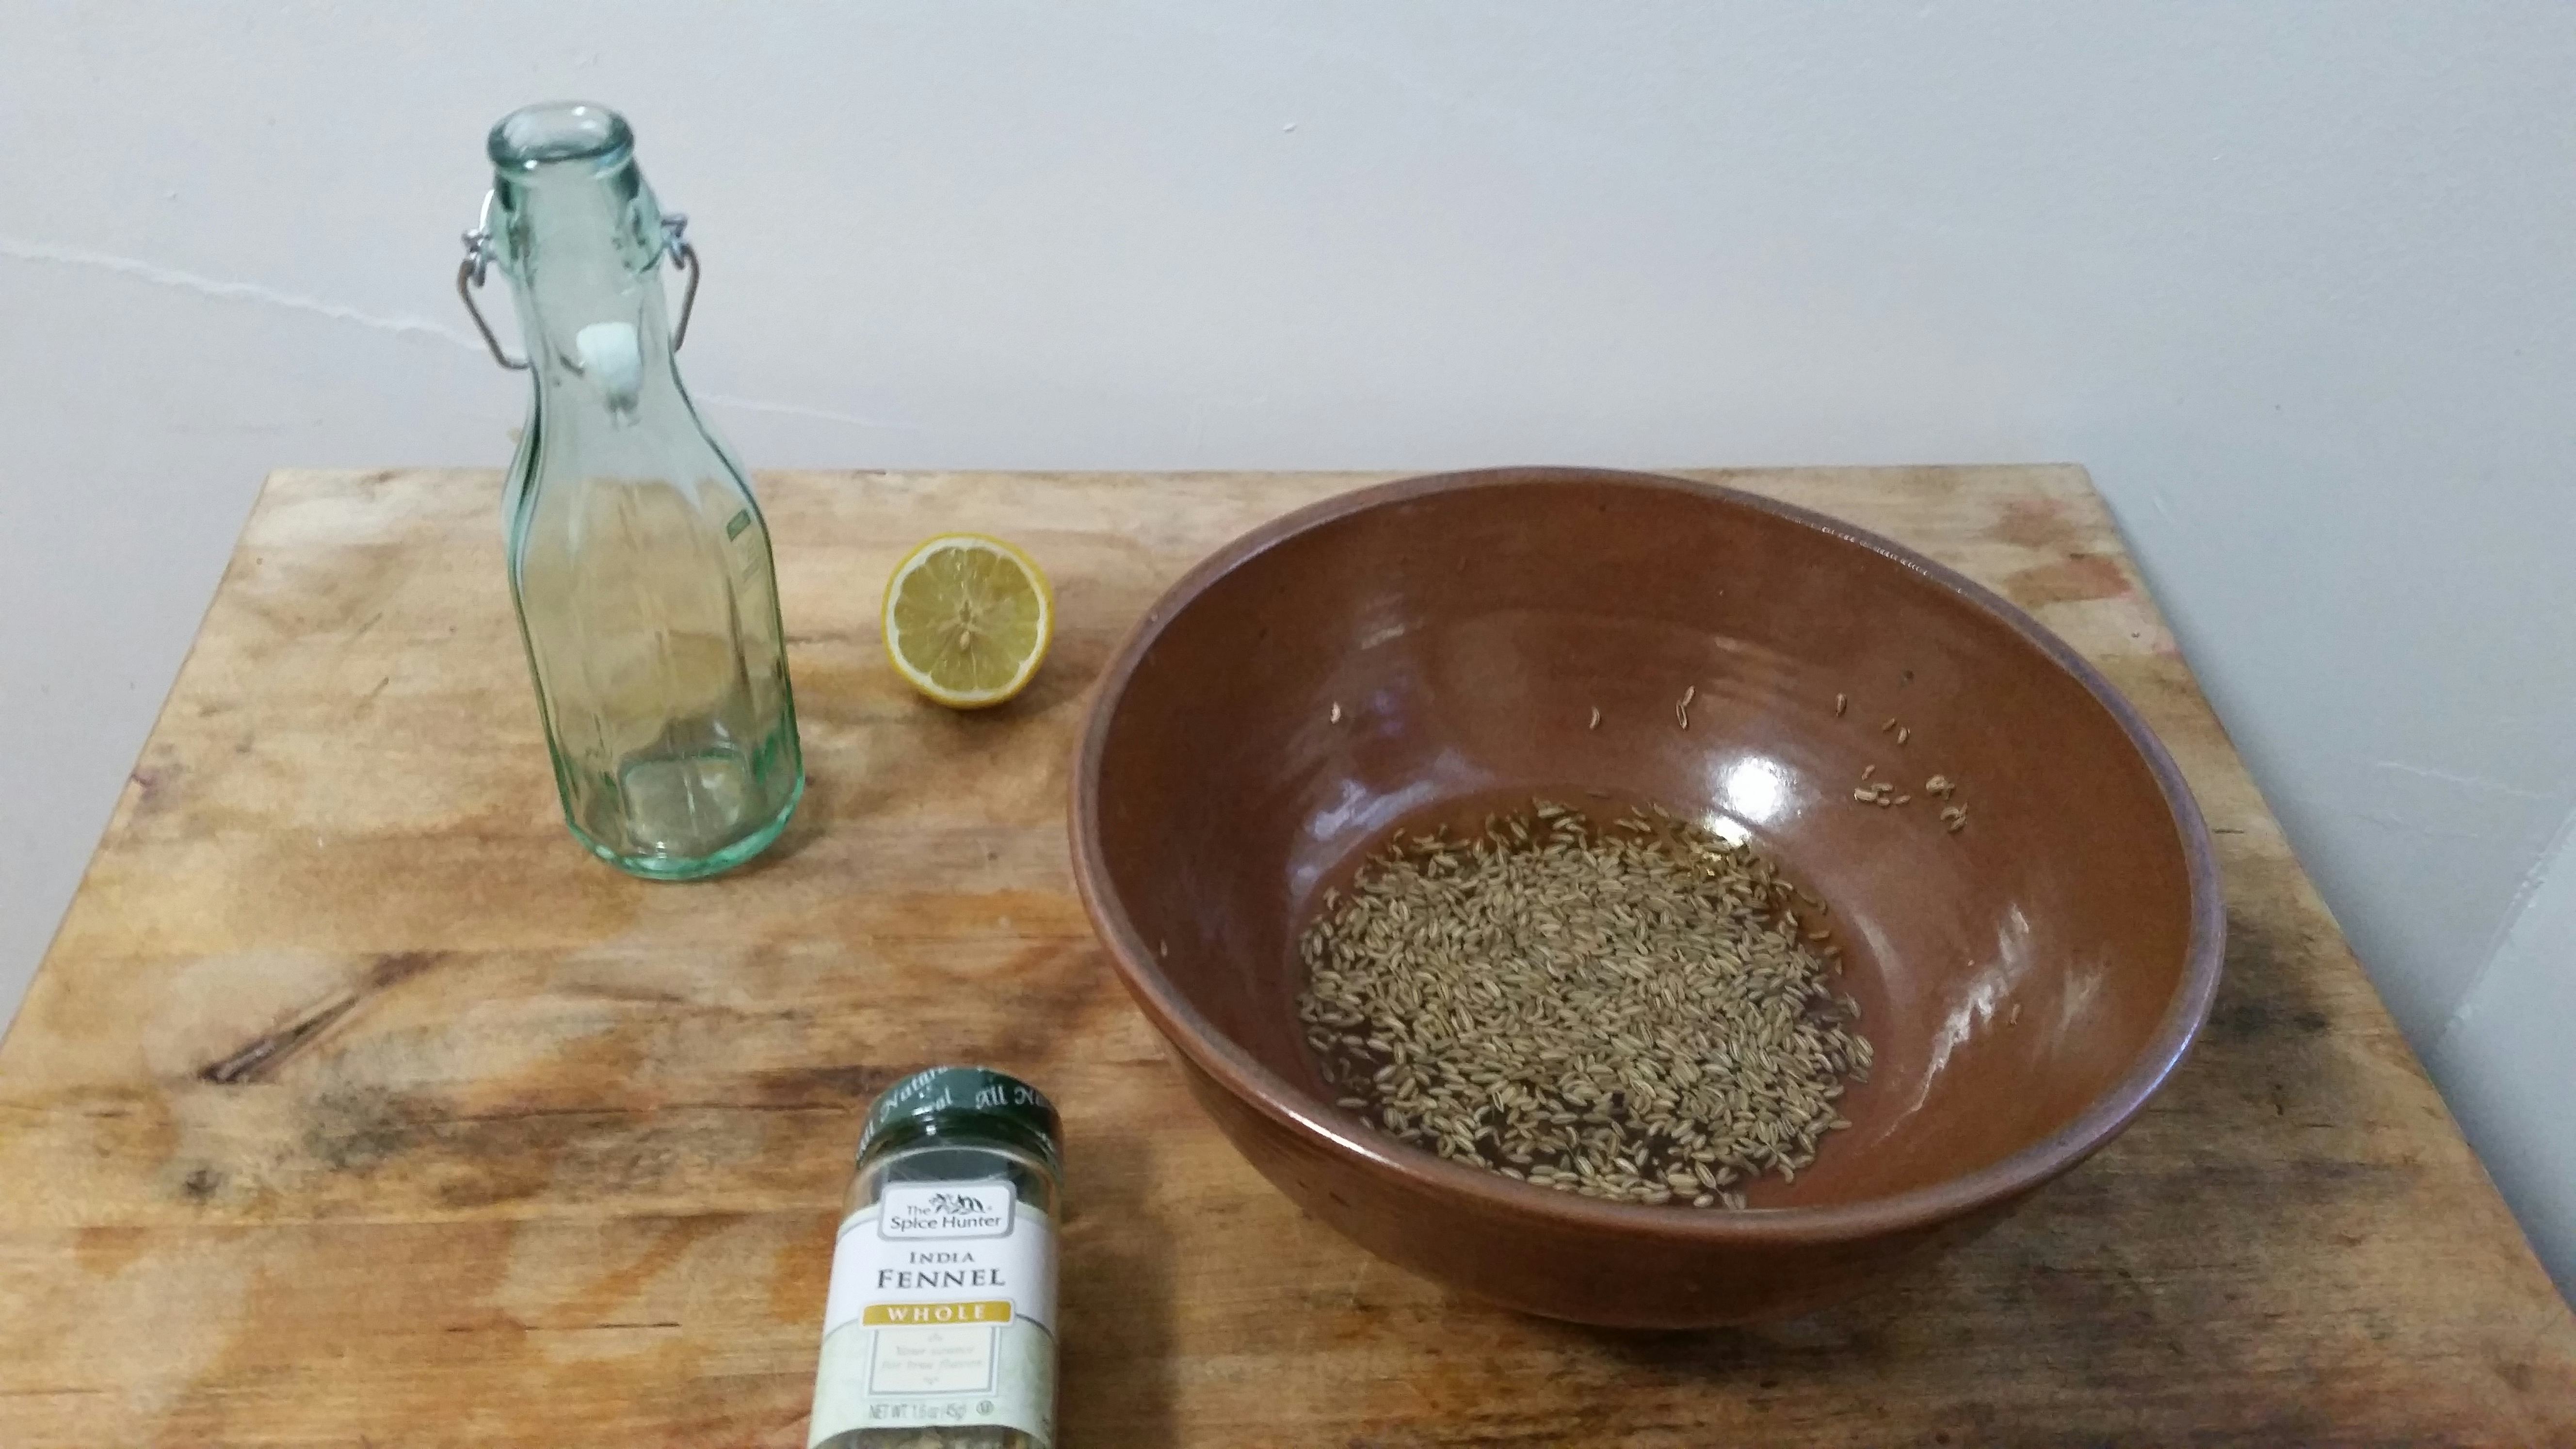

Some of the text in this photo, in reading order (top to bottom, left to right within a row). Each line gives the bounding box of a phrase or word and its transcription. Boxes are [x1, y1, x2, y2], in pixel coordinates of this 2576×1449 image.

[975, 1083, 1008, 1110] All
[907, 1205, 931, 1215] The
[890, 1216, 1002, 1232] Spice Hunter
[910, 1251, 975, 1264] INDIA
[878, 1268, 1006, 1288] FENNEL
[888, 1304, 986, 1322] WHOLE
